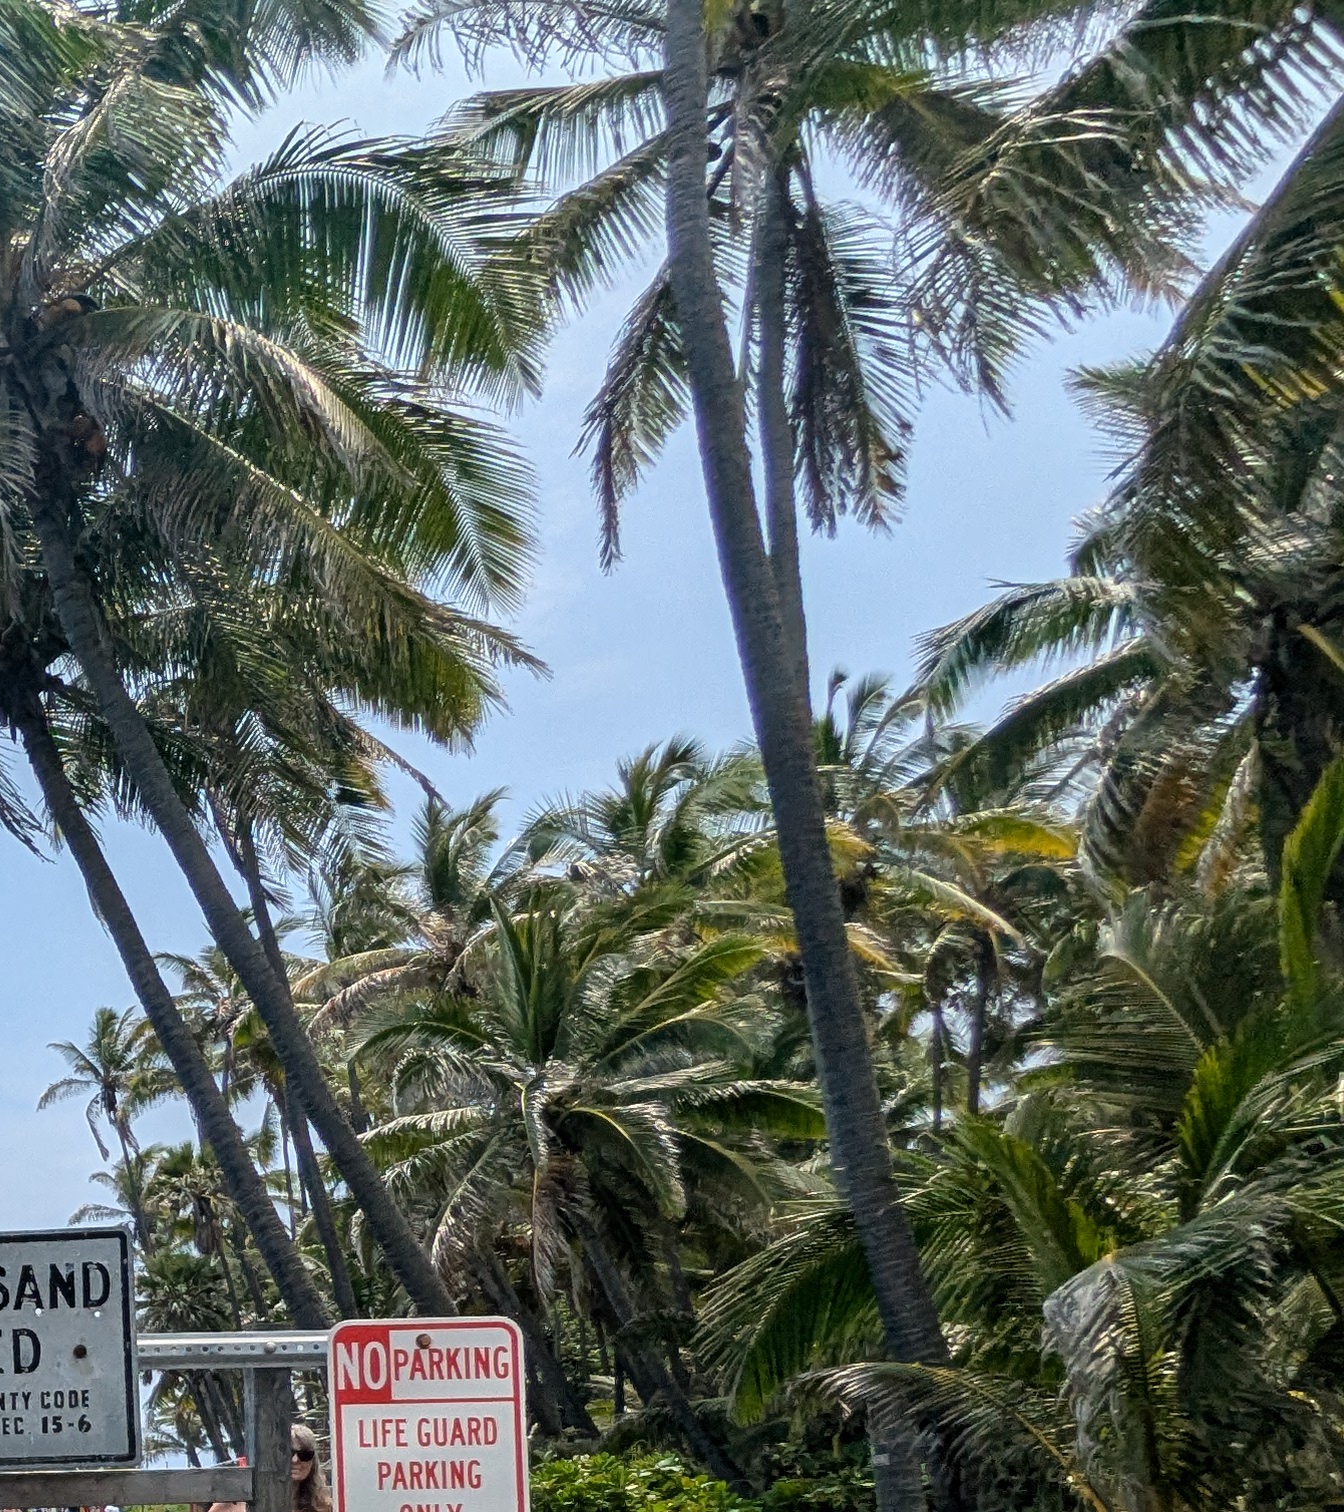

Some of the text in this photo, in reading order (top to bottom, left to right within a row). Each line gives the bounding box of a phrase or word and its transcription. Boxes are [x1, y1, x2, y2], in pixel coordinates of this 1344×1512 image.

[336, 1342, 509, 1391] NO PARKING
[40, 1390, 89, 1409] CODE
[357, 1417, 498, 1448] LIFE GUARD
[378, 1460, 482, 1490] PARKING
